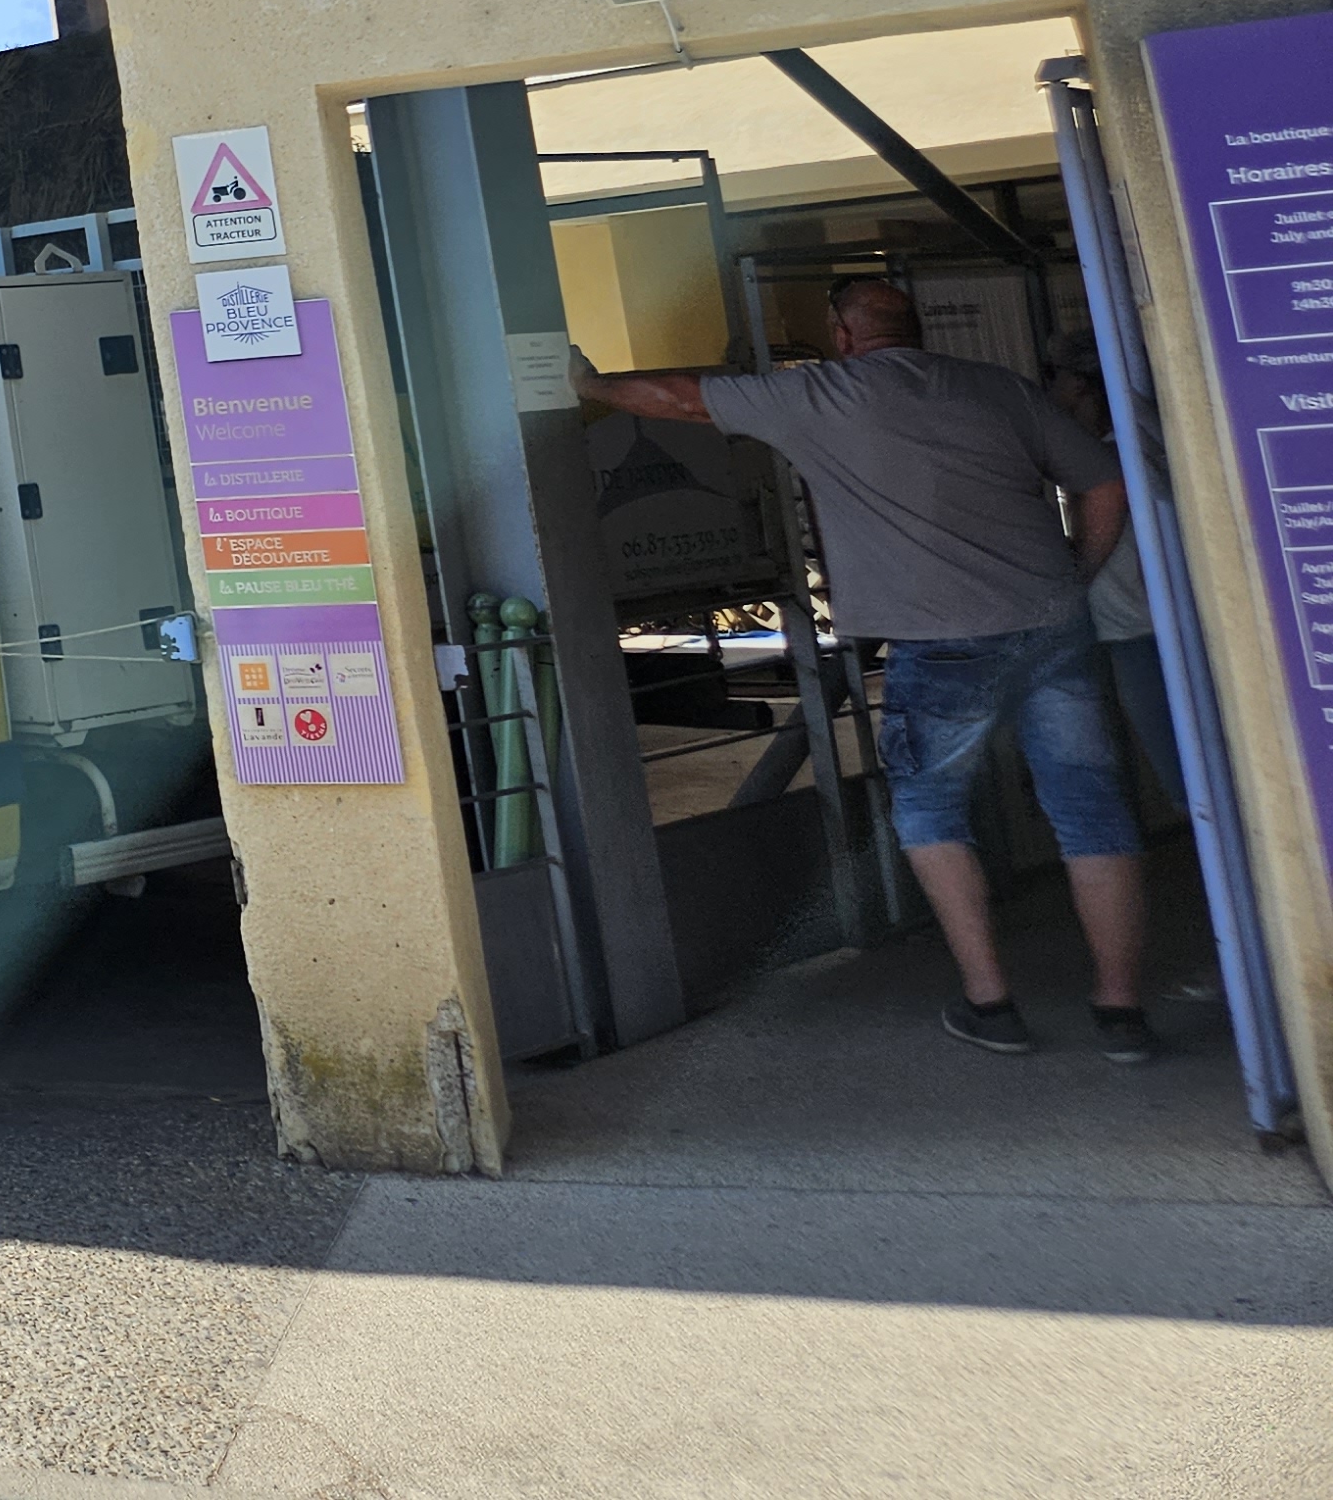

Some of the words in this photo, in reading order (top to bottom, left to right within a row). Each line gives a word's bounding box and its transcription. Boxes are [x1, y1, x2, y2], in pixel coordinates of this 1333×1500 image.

[1224, 134, 1248, 146] La
[1249, 126, 1330, 144] boutique
[1226, 162, 1332, 185] Horaires
[205, 215, 262, 229] ATTENTION
[209, 229, 261, 242] TRACTEUR
[226, 305, 268, 320] BLEU
[205, 315, 295, 334] PROVENCE
[192, 394, 313, 417] Bienvenue
[195, 421, 286, 442] Welcome
[219, 469, 305, 486] DISTILLERIE
[209, 507, 223, 522] la
[225, 506, 304, 522] BOUTIQUE
[231, 549, 331, 566] DÉCOUVERTE
[236, 579, 282, 595] PAUSE
[285, 578, 322, 593] BLEU
